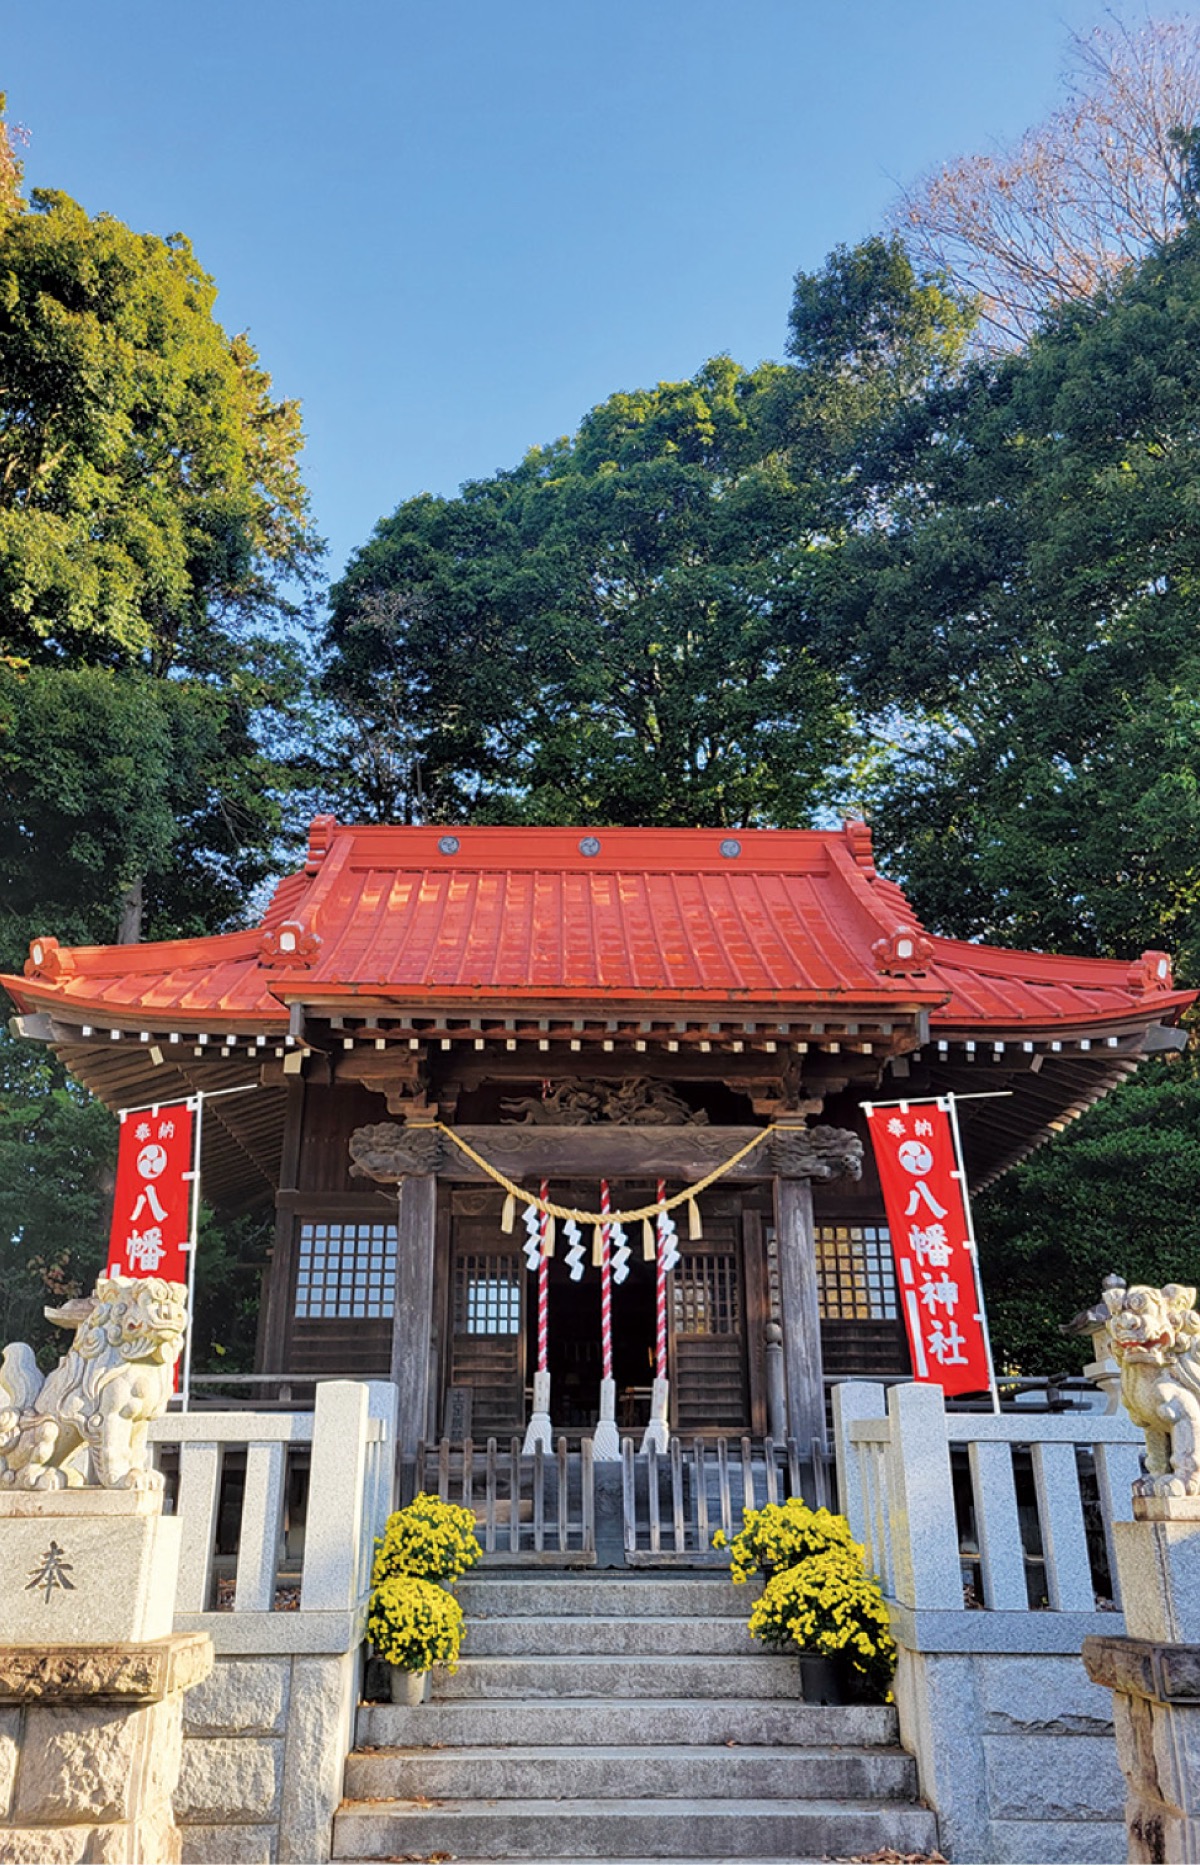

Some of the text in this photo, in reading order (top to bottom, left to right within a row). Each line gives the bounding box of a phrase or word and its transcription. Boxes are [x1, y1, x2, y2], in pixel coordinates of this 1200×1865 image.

[134, 1120, 175, 1142] 奉納
[887, 1117, 934, 1138] 奉納
[126, 1184, 169, 1277] 八幡
[904, 1180, 968, 1365] 八幡神社
[24, 1540, 77, 1605] 奉
